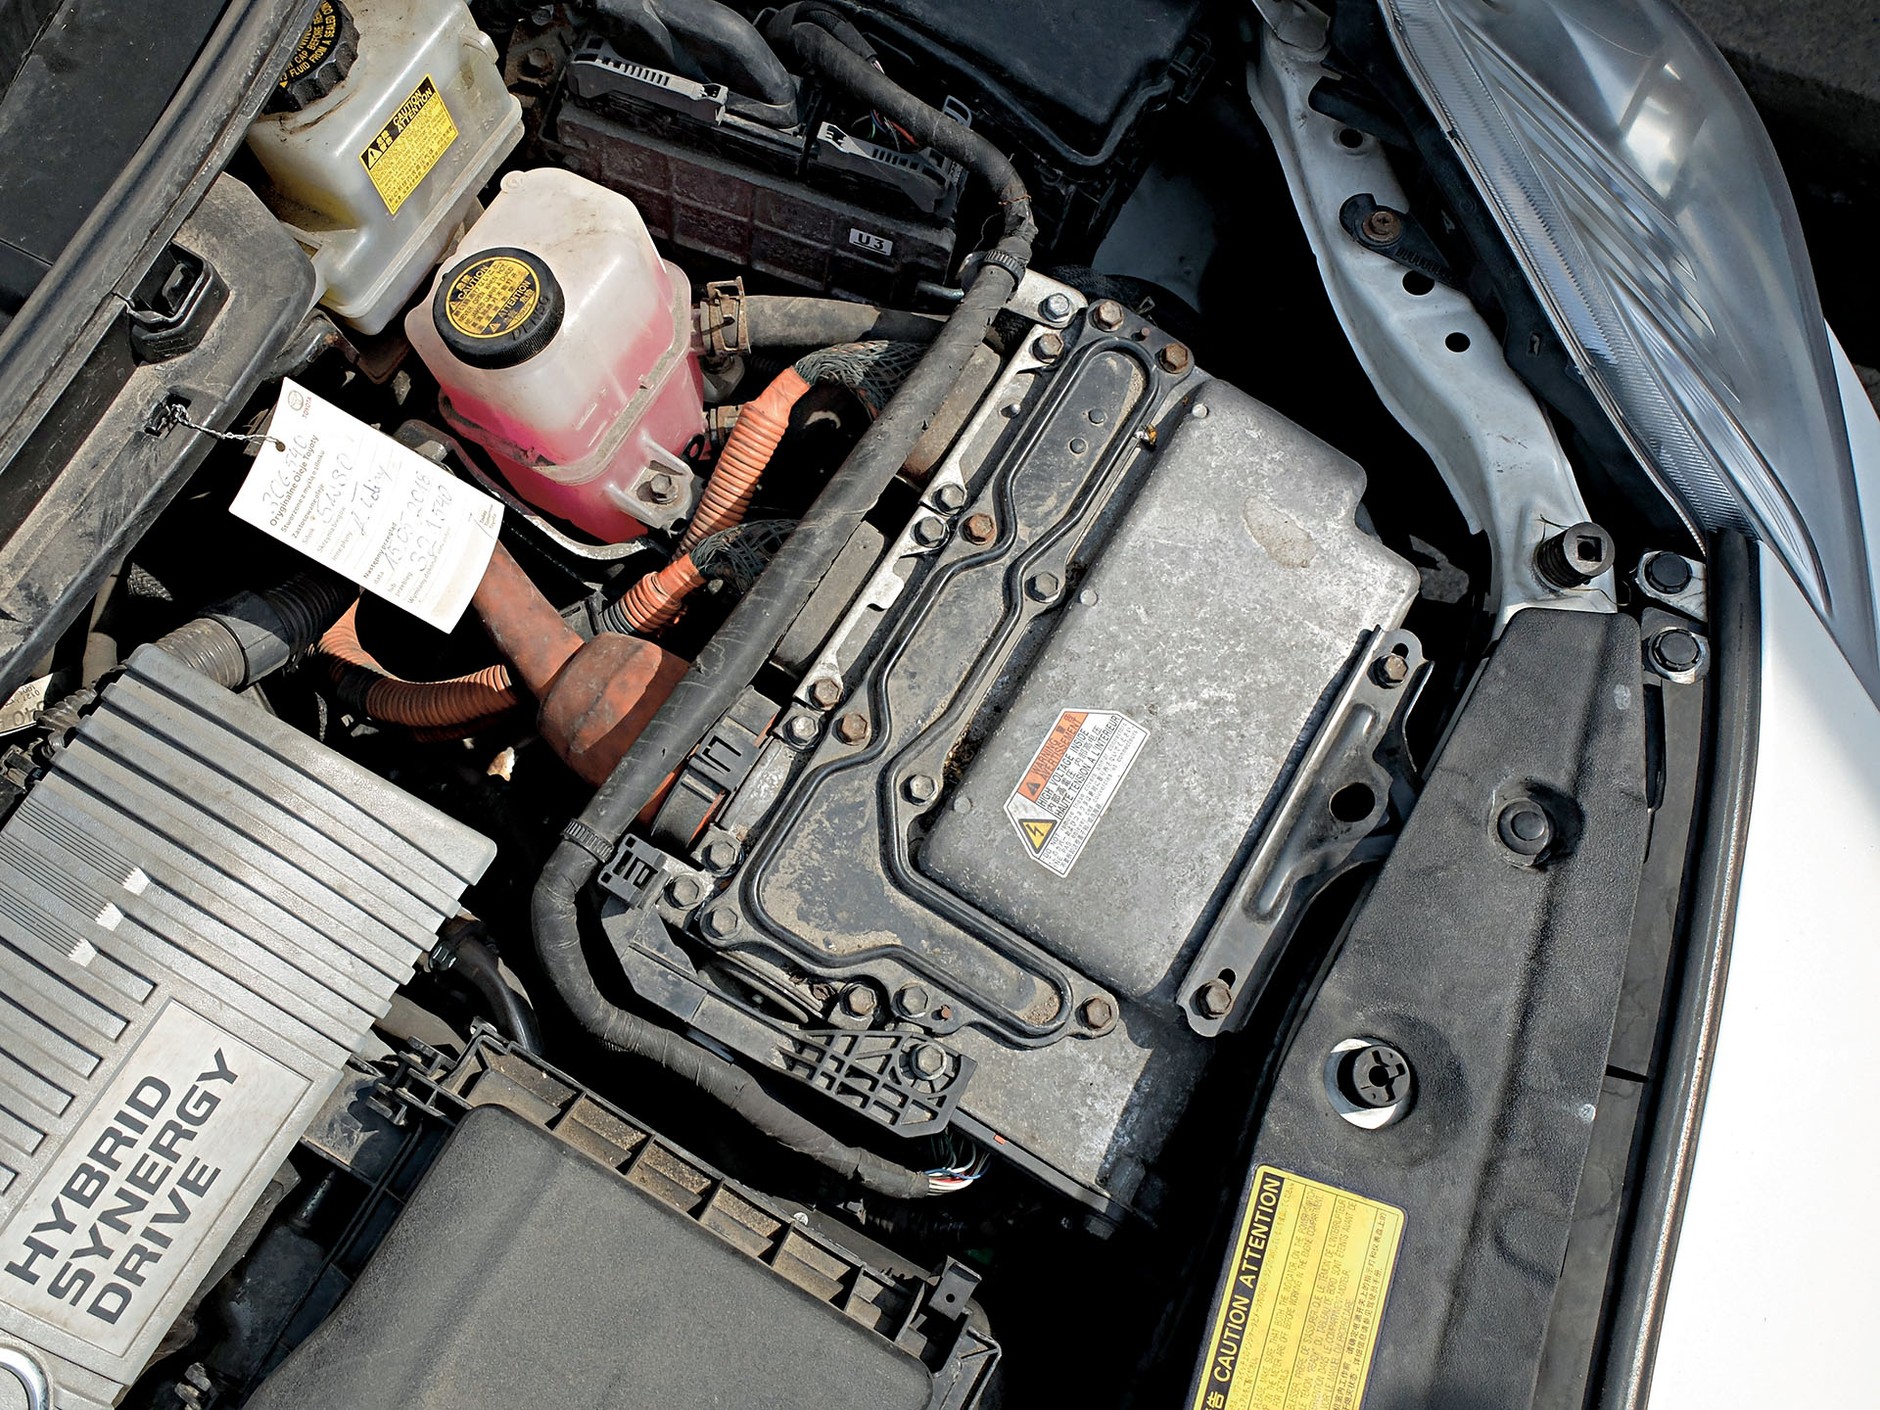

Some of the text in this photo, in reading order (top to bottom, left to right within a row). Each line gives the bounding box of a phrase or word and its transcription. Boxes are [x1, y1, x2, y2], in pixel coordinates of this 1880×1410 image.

[289, 61, 310, 78] FLUID
[309, 45, 328, 63] FROM
[294, 50, 308, 64] CAP
[392, 89, 423, 126] CAUTION
[396, 87, 433, 133] ATTENTION
[457, 264, 488, 301] CAUTION
[497, 278, 531, 319] ATTENTION
[511, 294, 550, 342] DENSO
[301, 396, 312, 419] TOYOTA
[269, 434, 320, 527] Oryginalne Oleje Toyoty
[280, 498, 304, 533] Stworzone
[291, 498, 318, 539] Zastosowane
[362, 549, 385, 579] Następny
[380, 521, 398, 550] przegląd
[1030, 737, 1059, 776] WARNING
[1037, 728, 1089, 808] HIGH VOLTAGE INSIDE
[1039, 716, 1082, 781] AVERTISSEMENT
[1053, 792, 1074, 818] HAUTE
[1067, 764, 1090, 793] TENSION
[4, 1076, 171, 1285] HYBRID
[47, 1047, 238, 1306] SYNERGY
[86, 1156, 222, 1325] DRIVE
[1213, 1294, 1250, 1383] CAUTION
[1238, 1177, 1281, 1289] ATTENTION
